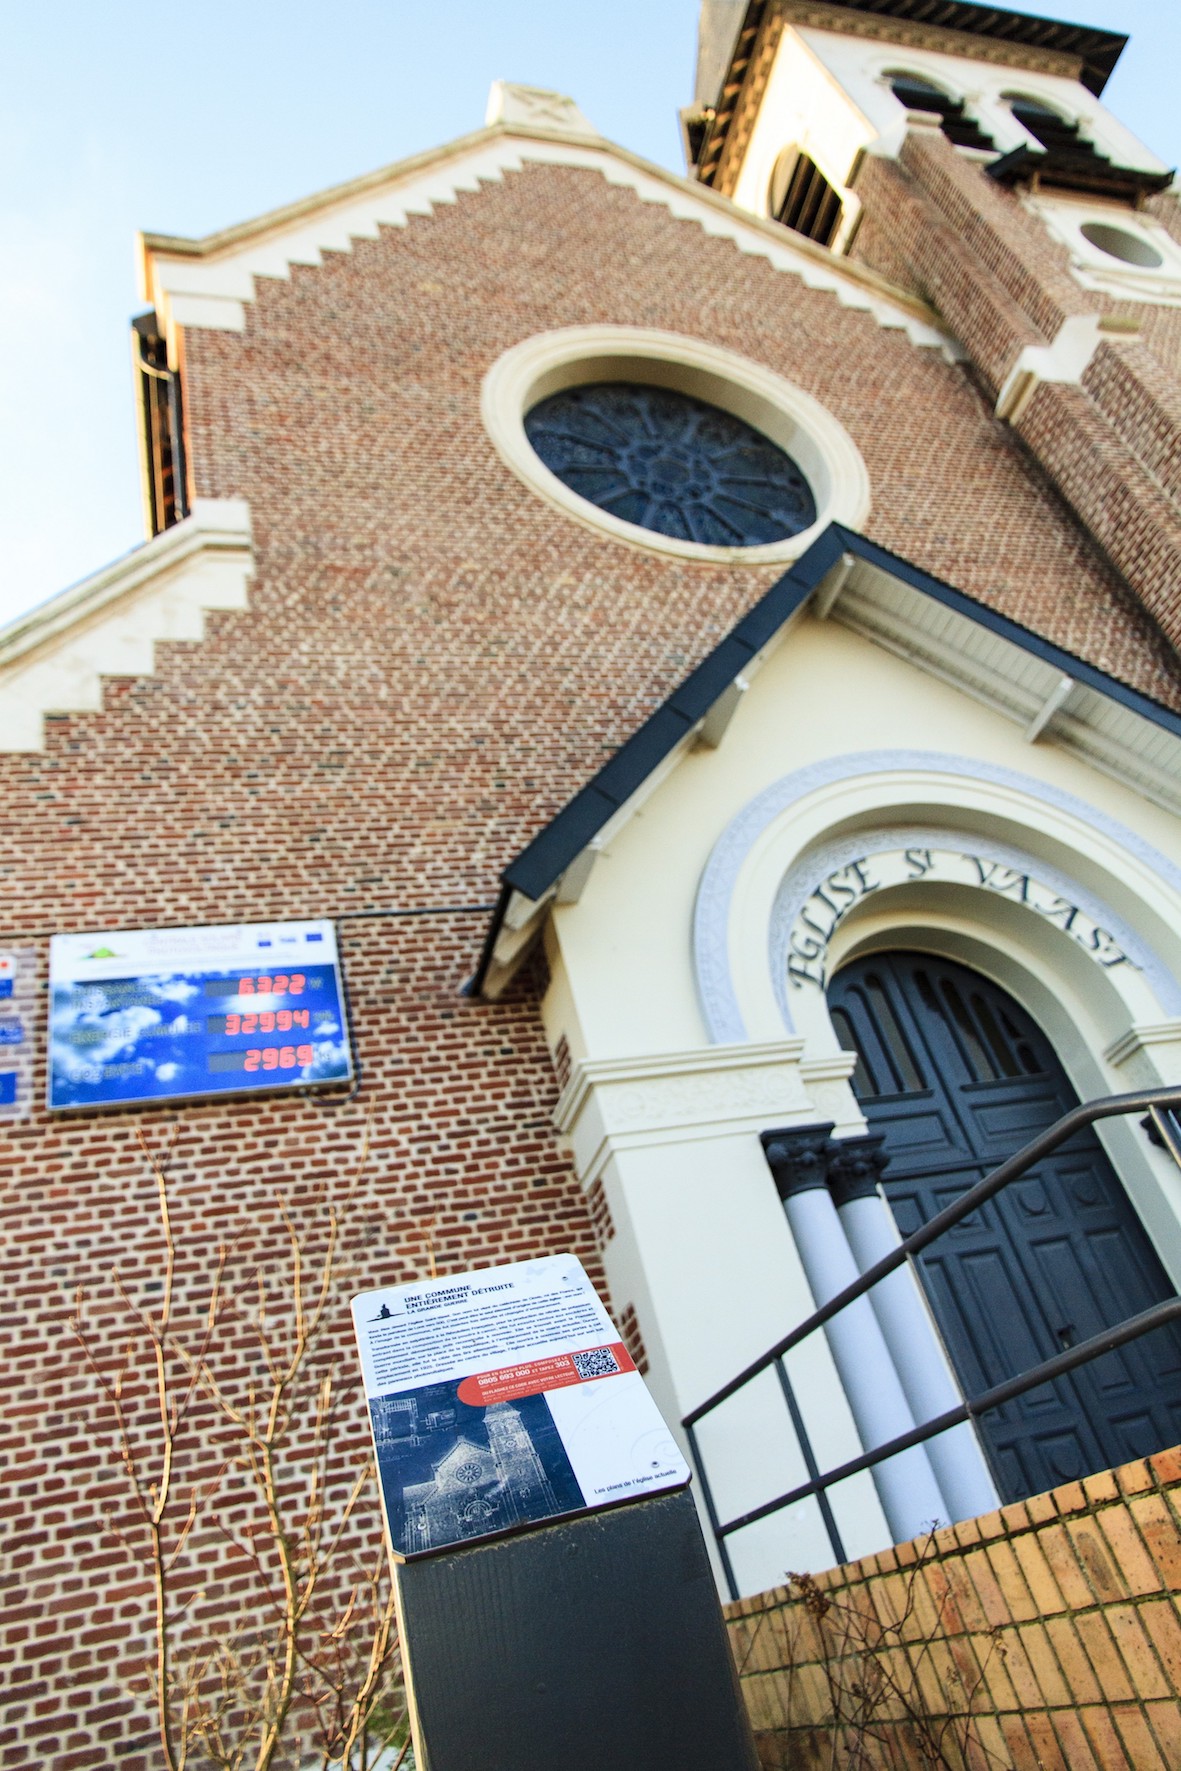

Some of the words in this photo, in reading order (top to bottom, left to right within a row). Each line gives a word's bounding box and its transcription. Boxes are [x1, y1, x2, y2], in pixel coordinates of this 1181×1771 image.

[961, 854, 1145, 972] VAAST
[238, 973, 306, 996] 6322
[224, 1009, 310, 1036] 32994
[243, 1044, 314, 1072] 2969
[405, 1295, 423, 1303] UNE
[425, 1285, 471, 1299] COMMUNE
[472, 1282, 514, 1296] DÉTRUITE
[417, 1304, 442, 1312] GRANDE
[444, 1299, 467, 1307] GUERRE
[478, 1377, 498, 1386] 0805
[515, 1369, 530, 1377] 000
[606, 1483, 622, 1492] plans
[632, 1476, 653, 1484] l'église
[654, 1469, 676, 1478] actuelle
